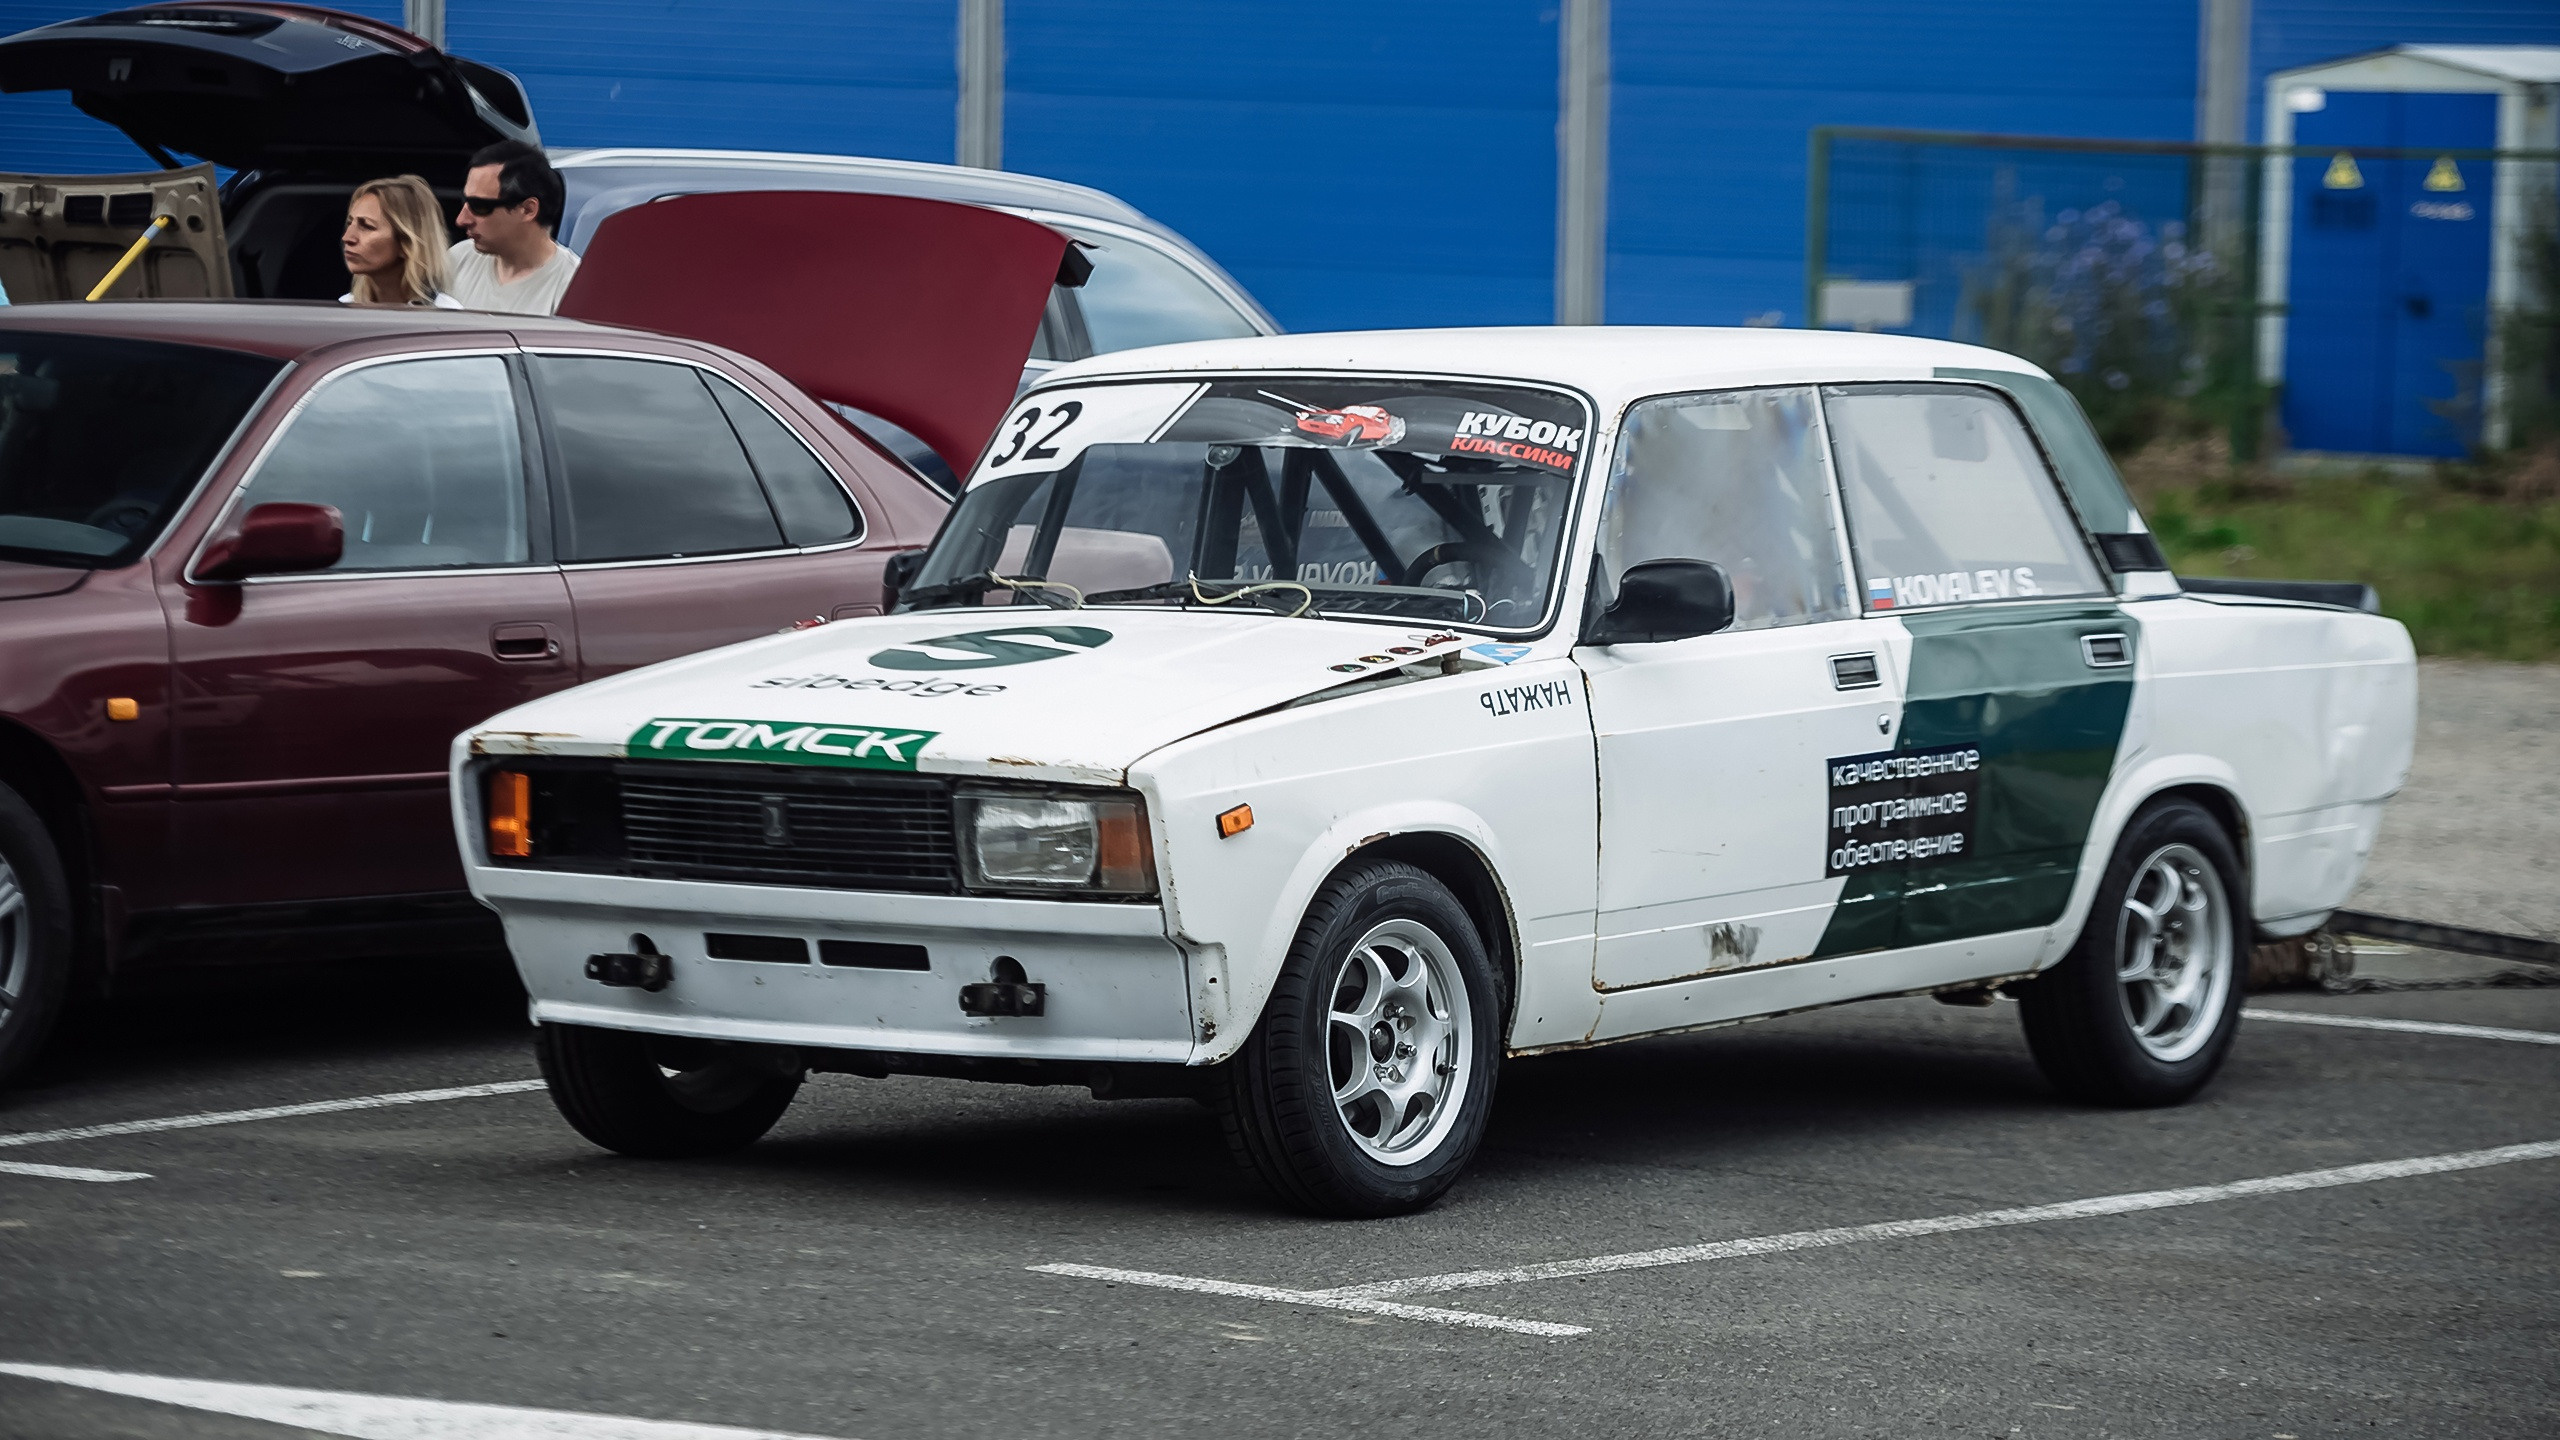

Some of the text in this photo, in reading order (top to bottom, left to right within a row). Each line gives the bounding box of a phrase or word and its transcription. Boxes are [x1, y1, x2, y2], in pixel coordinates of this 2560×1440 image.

[990, 401, 1083, 469] 32
[1456, 411, 1584, 453] КУБОК
[1450, 437, 1574, 471] КЛАССИКИ
[1892, 569, 2011, 608] KOVALEV
[748, 672, 1008, 698] sibedge
[1479, 679, 1573, 718] НАЖАТЬ
[650, 719, 926, 763] ТОМСК
[1831, 749, 1980, 787] качественное
[1832, 791, 1968, 834] программное
[1830, 831, 1965, 870] обеспечение
